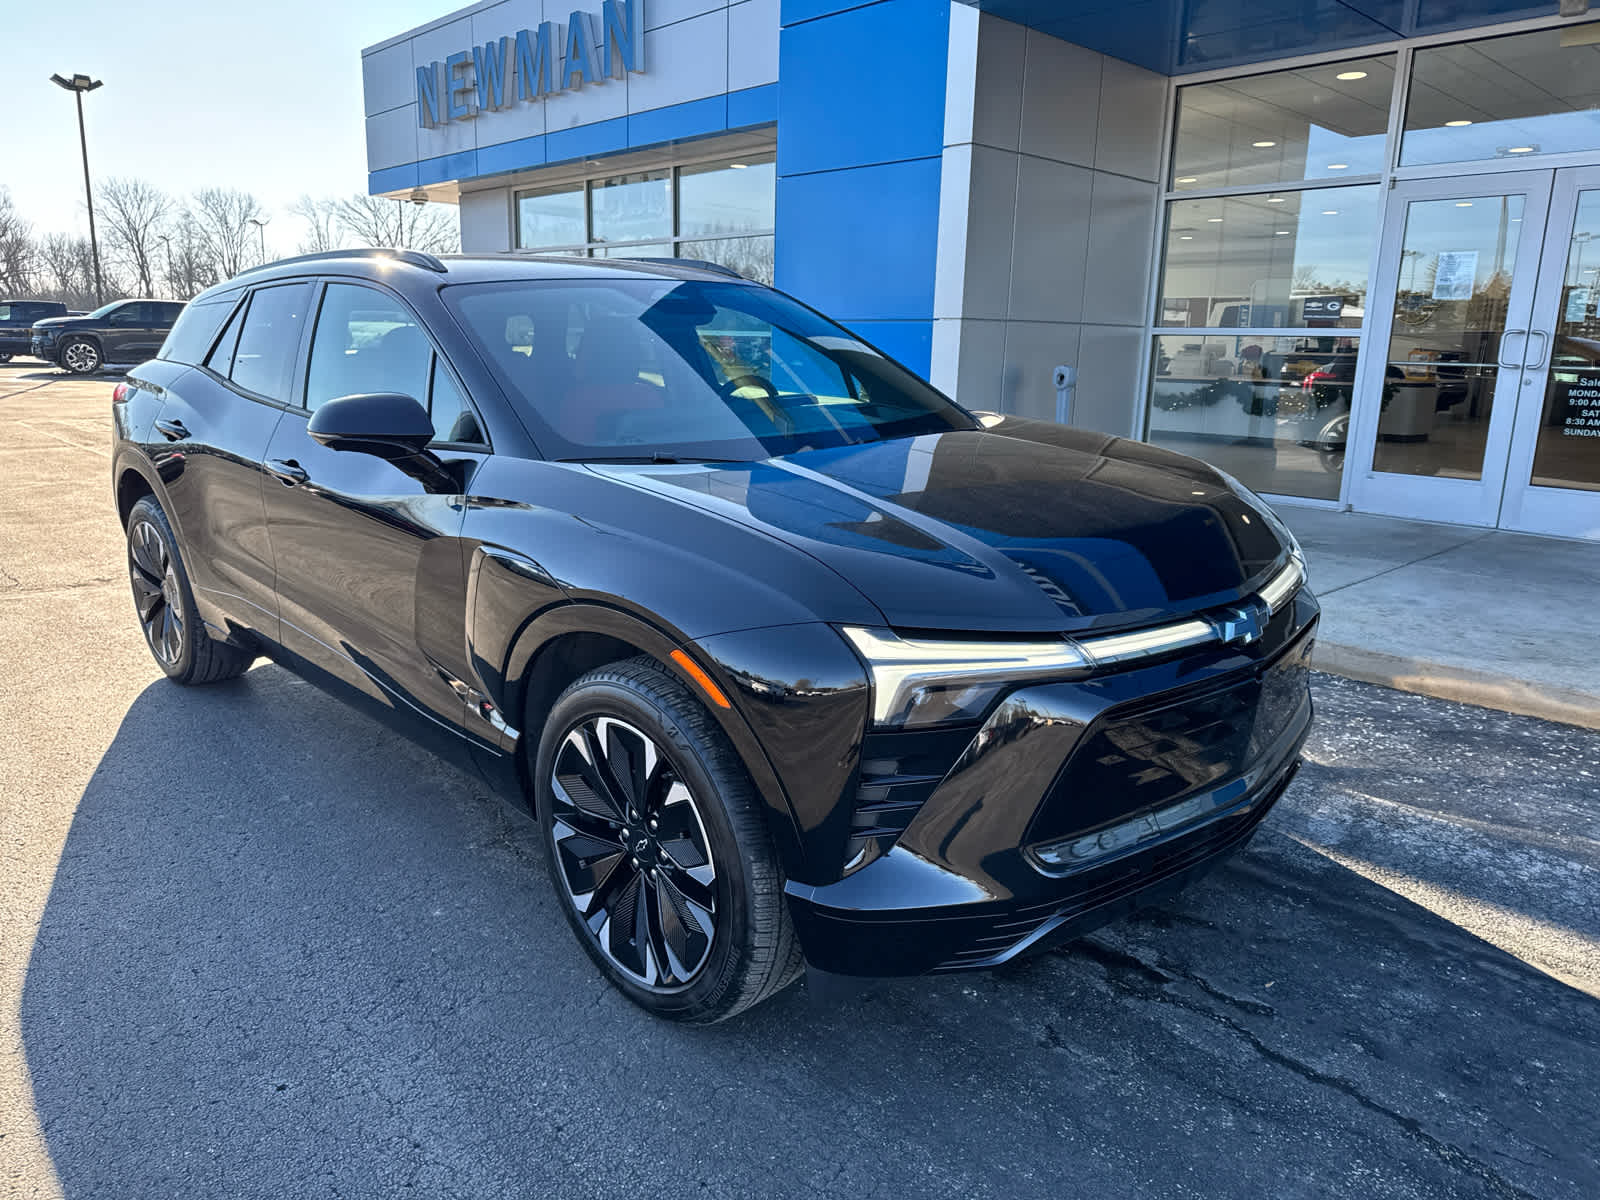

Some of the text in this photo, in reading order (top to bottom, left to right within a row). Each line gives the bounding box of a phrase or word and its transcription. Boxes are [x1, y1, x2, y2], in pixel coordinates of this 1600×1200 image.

[416, 0, 645, 128] NEWMAN
[1569, 398, 1600, 407] 9:00 A
[1581, 409, 1600, 417] SAT
[1565, 417, 1585, 425] 8:30
